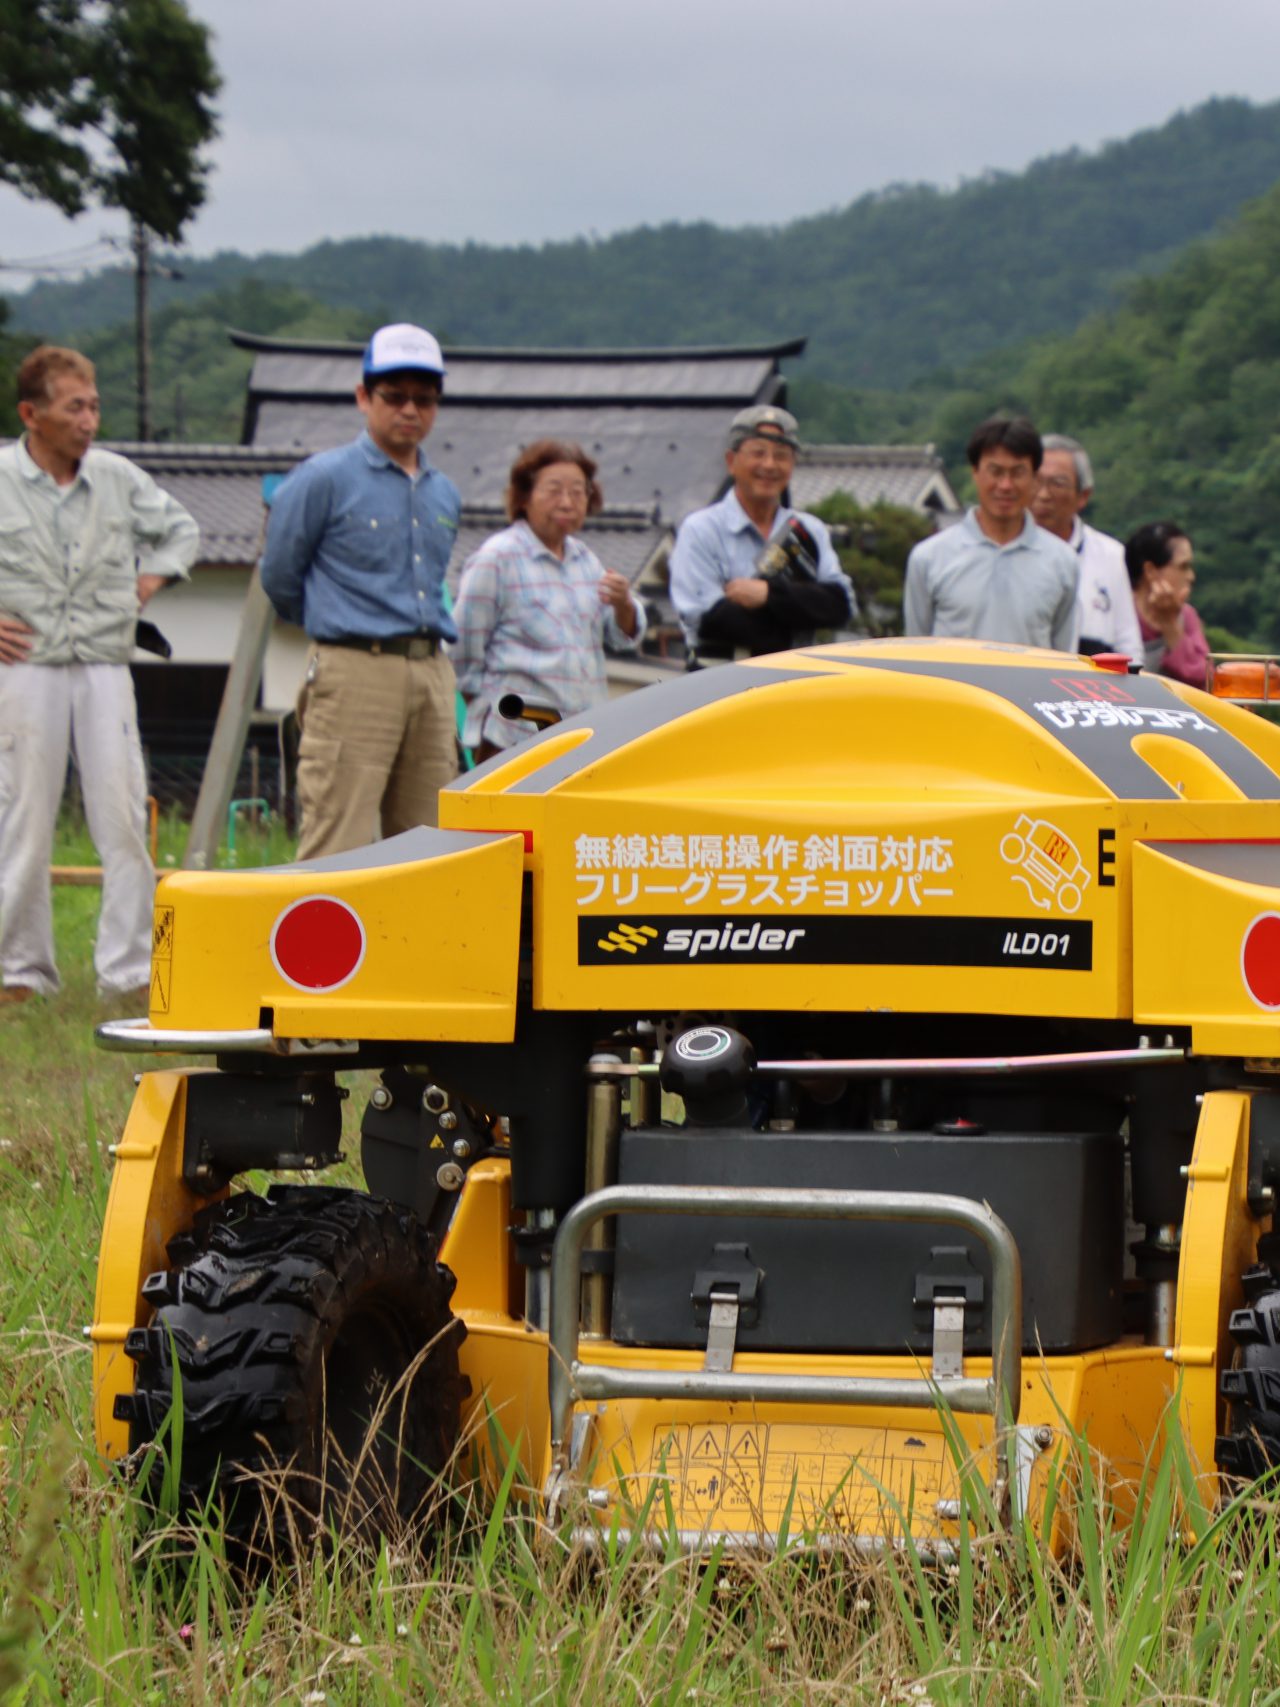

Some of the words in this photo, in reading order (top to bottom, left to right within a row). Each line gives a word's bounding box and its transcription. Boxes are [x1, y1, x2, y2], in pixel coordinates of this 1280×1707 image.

[1039, 704, 1218, 733] レンタルコトス
[1098, 828, 1116, 886] E
[575, 871, 954, 906] フリーグラスチョッパー
[663, 922, 806, 958] spider
[1002, 932, 1070, 957] ILD01
